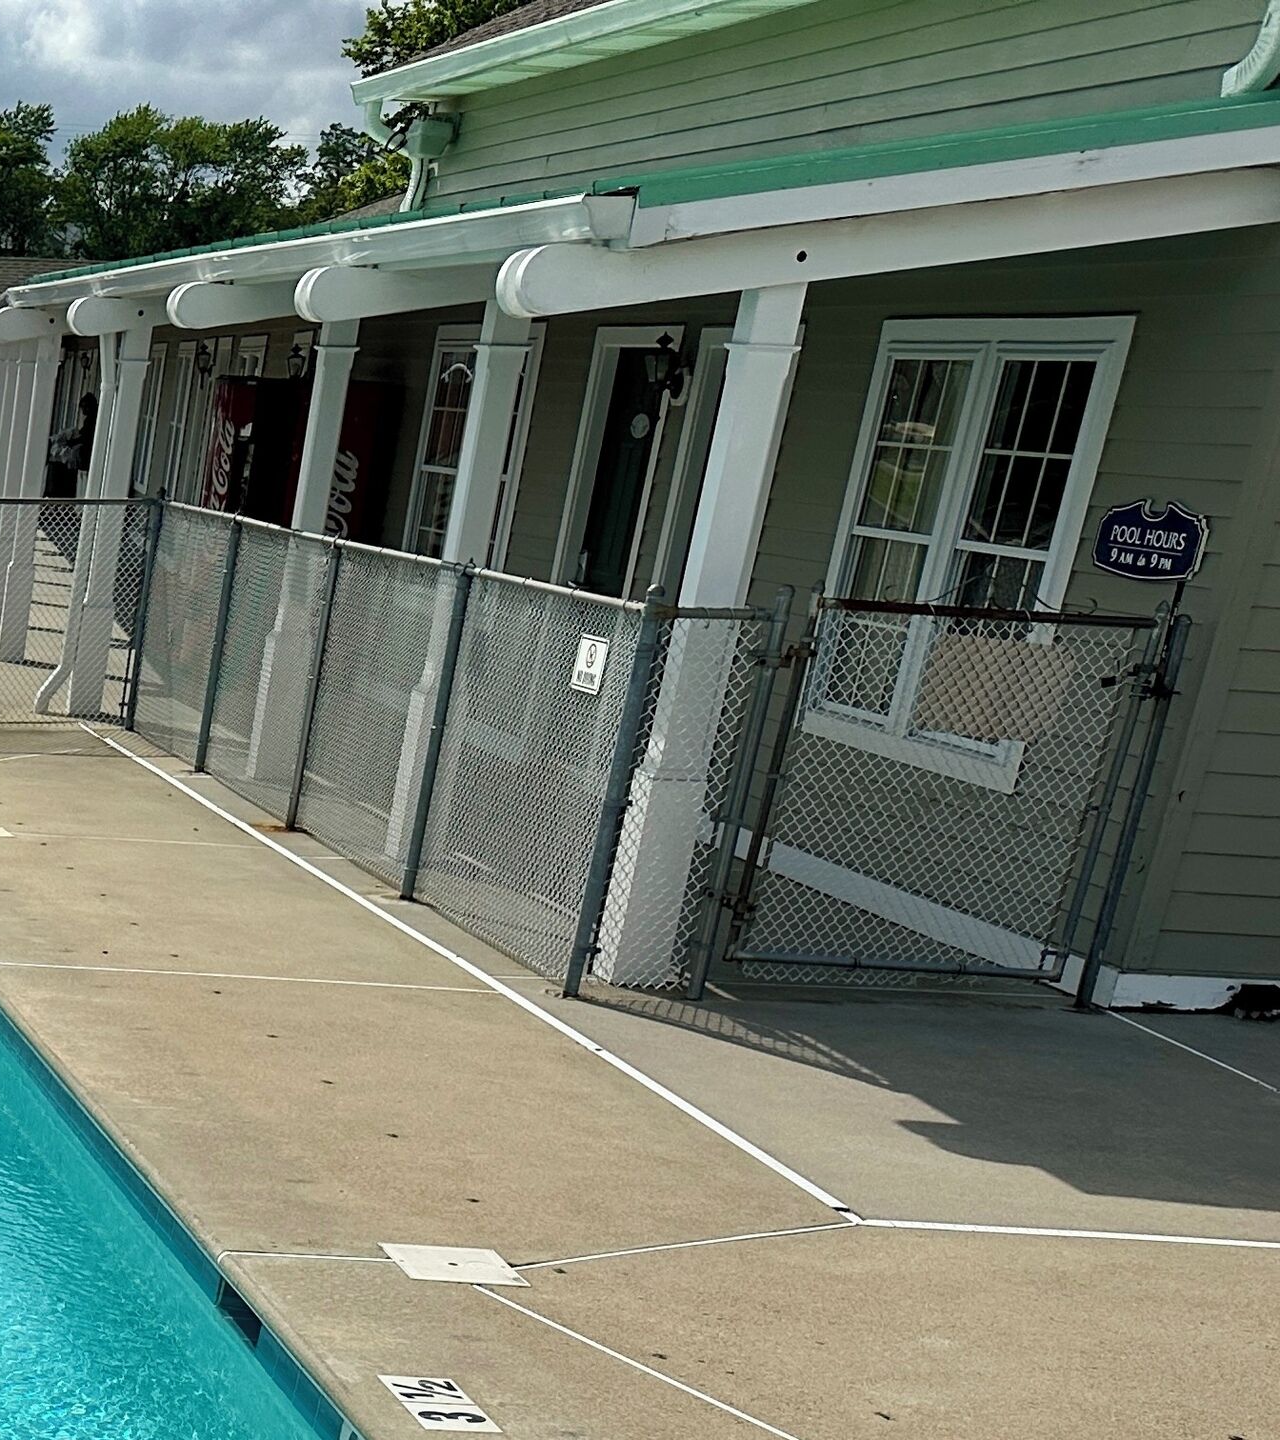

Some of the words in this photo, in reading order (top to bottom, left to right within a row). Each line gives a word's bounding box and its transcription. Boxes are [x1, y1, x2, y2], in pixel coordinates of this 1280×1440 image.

[1110, 524, 1142, 545] POOL
[1143, 528, 1188, 551] HOURS
[1109, 547, 1119, 562] 9
[1118, 552, 1134, 565] AM
[1149, 553, 1159, 568] 9
[1158, 557, 1172, 571] PM
[417, 1410, 487, 1424] 3
